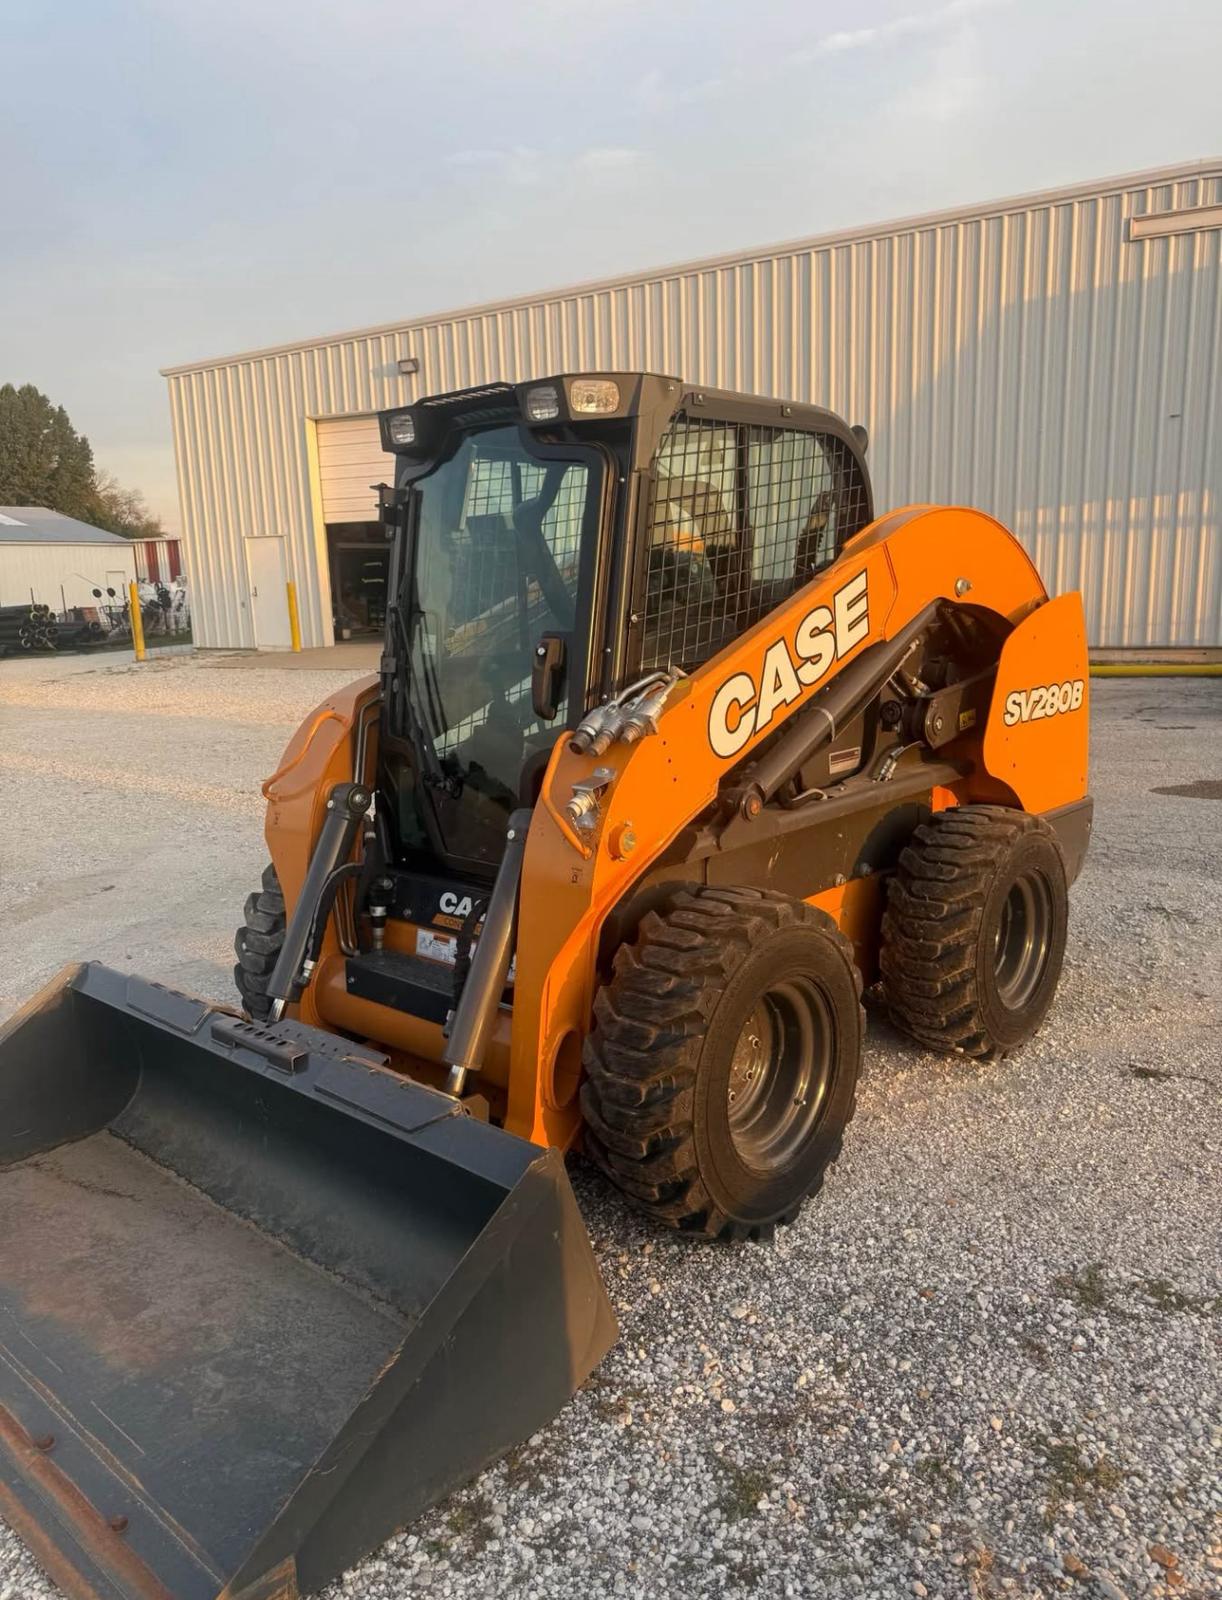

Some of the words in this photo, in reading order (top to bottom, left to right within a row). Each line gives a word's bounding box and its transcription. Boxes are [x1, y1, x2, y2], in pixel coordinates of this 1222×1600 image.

[708, 568, 869, 759] CASE
[1004, 679, 1084, 727] SV280B
[439, 892, 486, 921] CA
